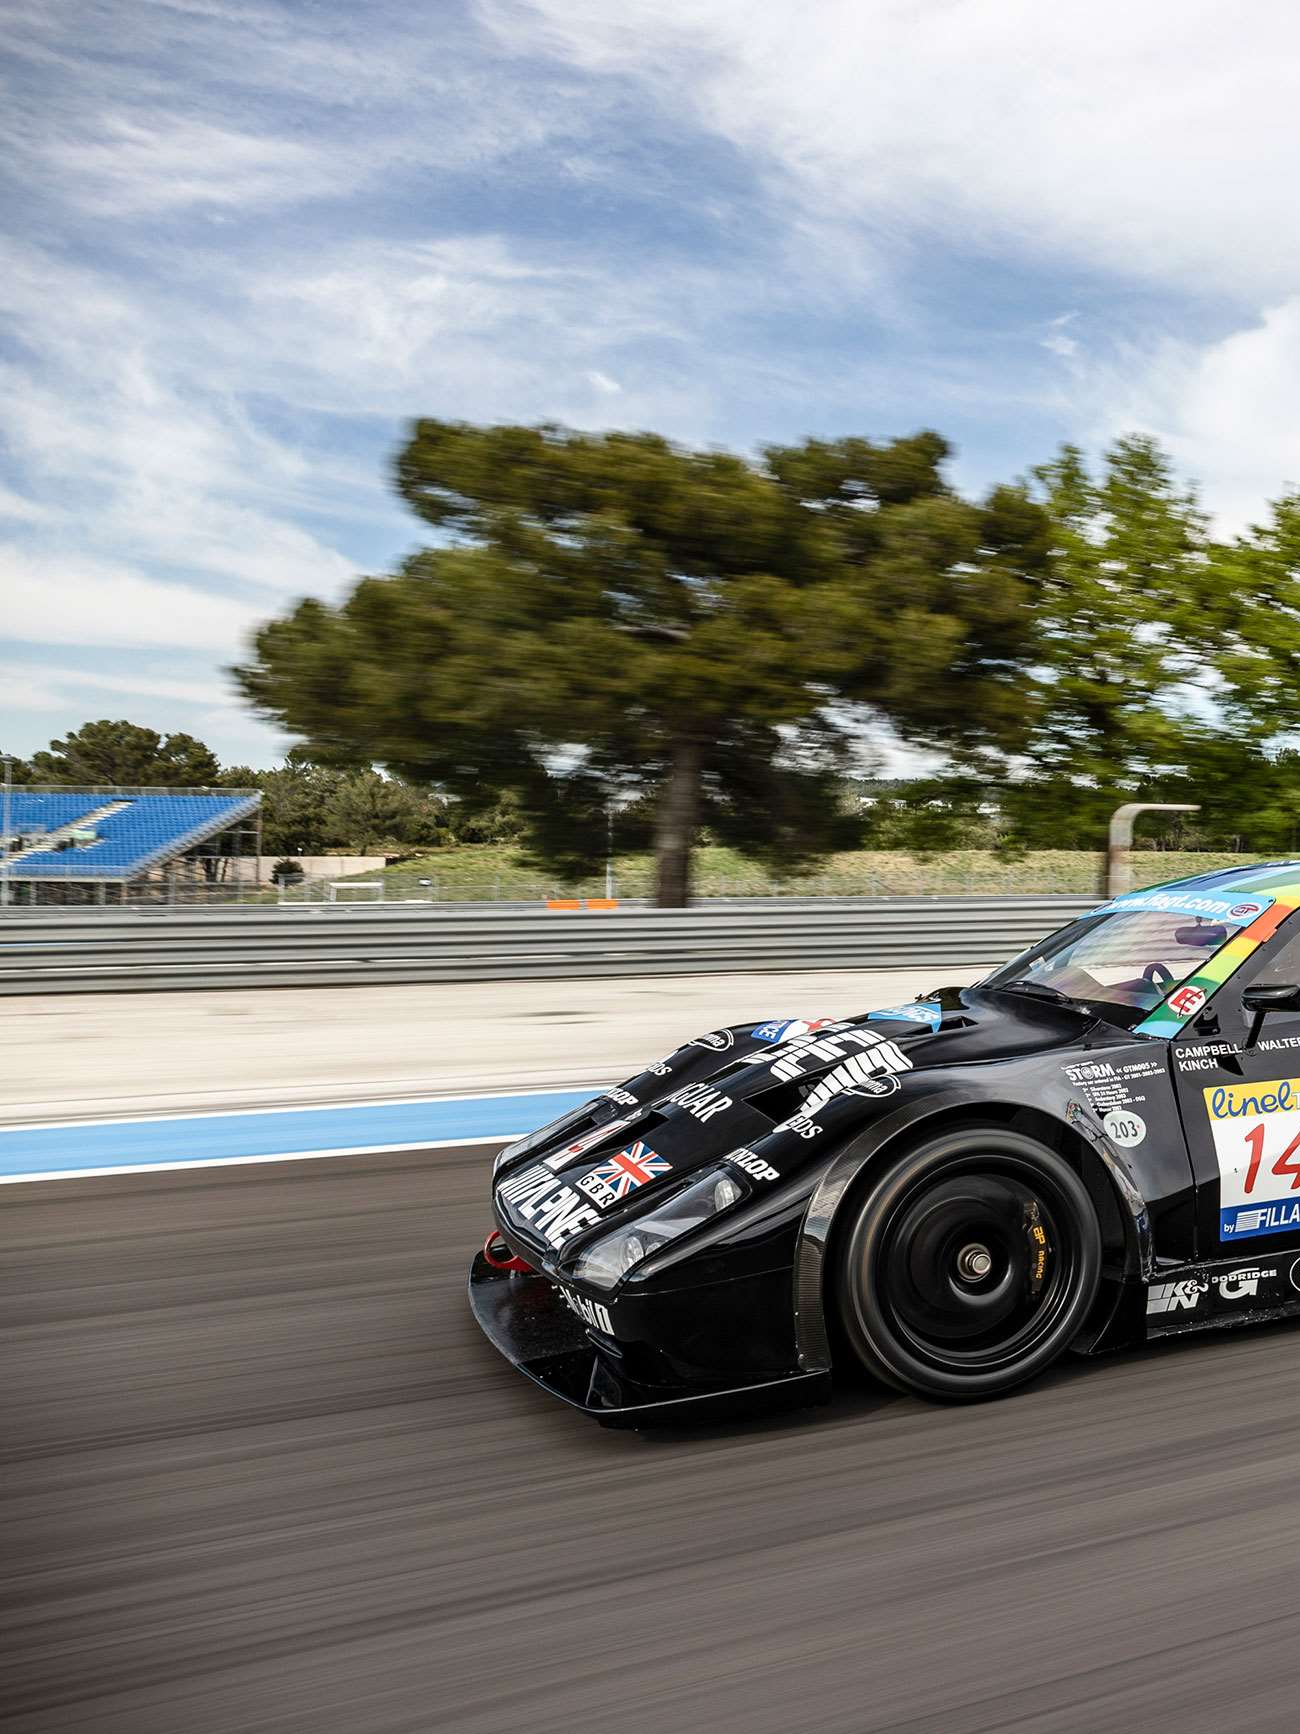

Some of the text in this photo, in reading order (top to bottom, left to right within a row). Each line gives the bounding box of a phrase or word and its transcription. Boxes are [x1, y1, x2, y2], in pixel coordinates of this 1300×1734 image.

[1175, 1043, 1243, 1059] CAMPBELL
[1178, 1058, 1219, 1072] KINCH
[785, 1115, 824, 1139] EDS
[1111, 1120, 1138, 1139] 203
[579, 1174, 617, 1206] GBR
[1223, 1222, 1236, 1234] by
